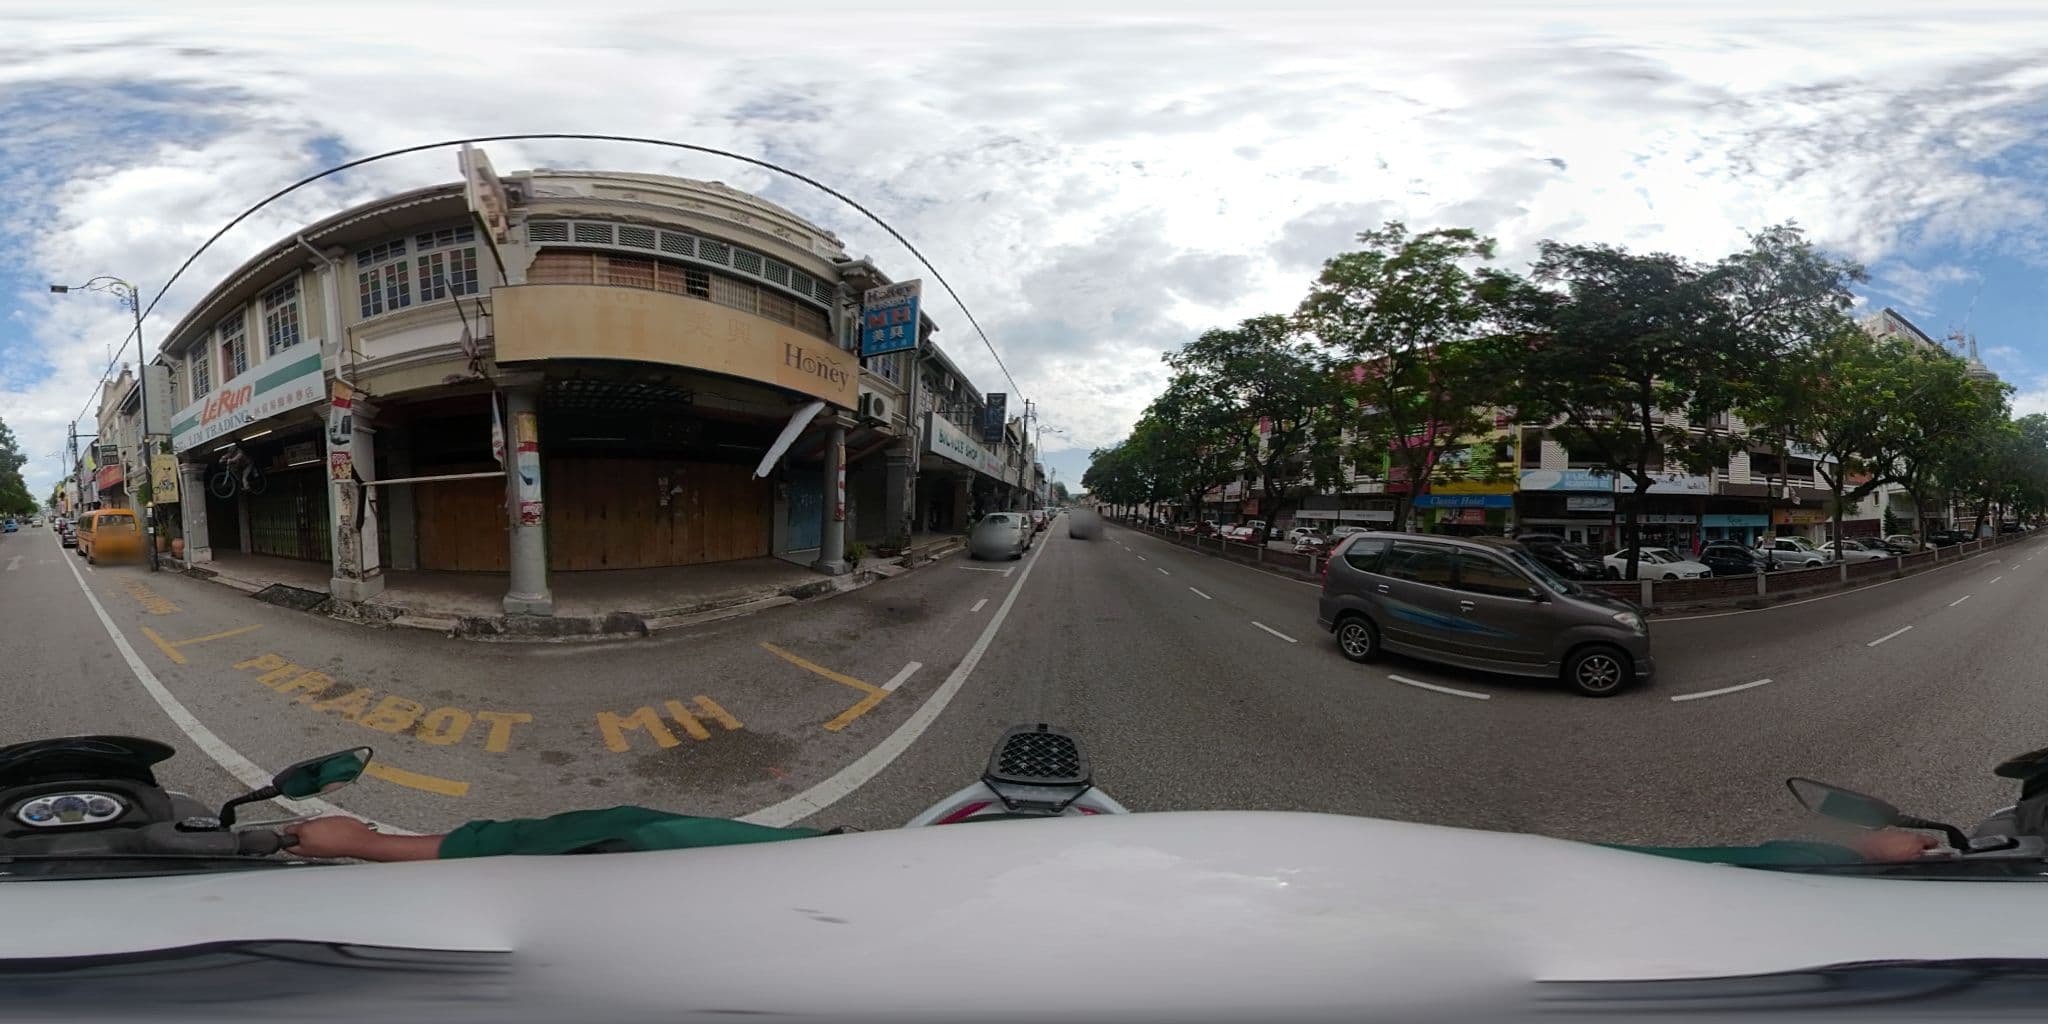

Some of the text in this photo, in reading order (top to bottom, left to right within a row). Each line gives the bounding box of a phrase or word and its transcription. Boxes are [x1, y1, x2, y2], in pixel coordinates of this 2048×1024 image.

[784, 342, 849, 393] Honey
[232, 653, 745, 753] PERABOT MH
